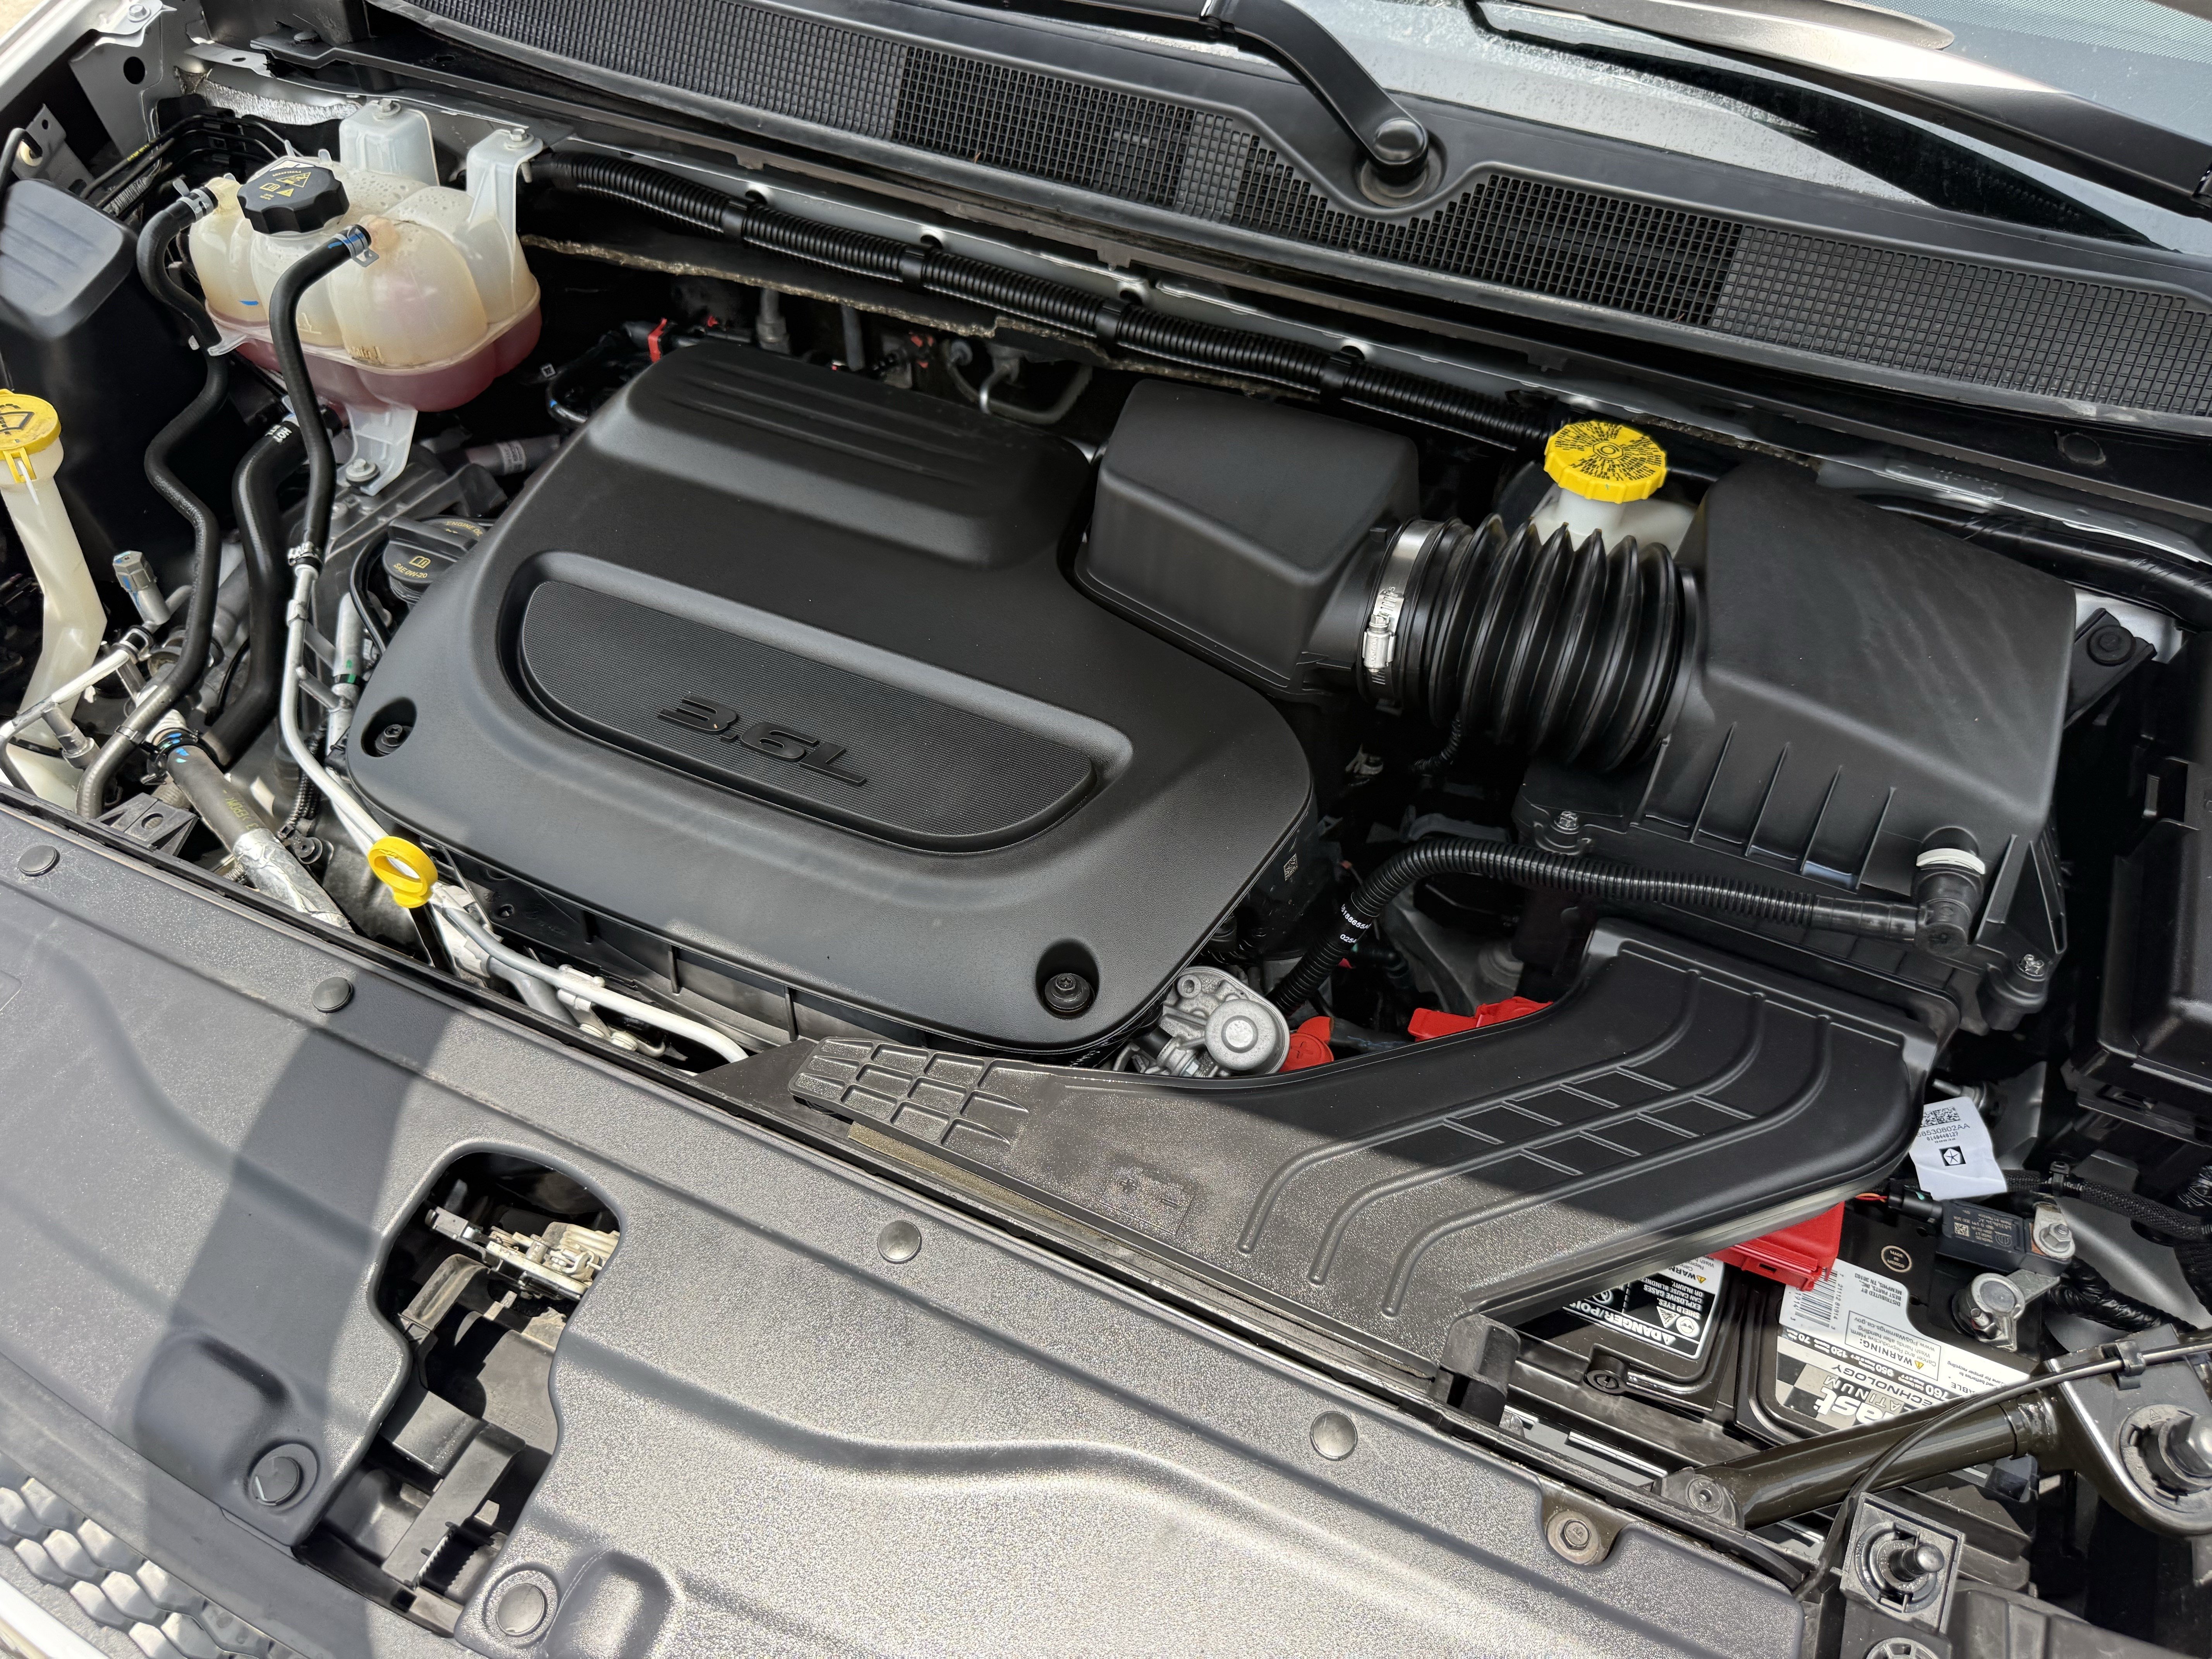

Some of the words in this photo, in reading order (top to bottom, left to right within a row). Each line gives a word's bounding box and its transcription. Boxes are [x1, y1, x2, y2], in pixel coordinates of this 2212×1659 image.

[273, 427, 292, 443] HOT
[446, 521, 475, 531] ENGINE
[393, 563, 408, 575] SAE
[405, 570, 428, 578] 0W-20
[658, 697, 867, 787] 3.6L
[1700, 1259, 1714, 1268] Wash
[1854, 1273, 1869, 1282] 38103
[1643, 1284, 1665, 1298] GASES
[1669, 1288, 1688, 1299] CAUSE
[1671, 1281, 1693, 1294] INJURY.
[1665, 1292, 1702, 1311] EXPLOSIVE
[1690, 1295, 1703, 1304] CAN
[1869, 1291, 1901, 1307] DISTRIBUTED
[1889, 1293, 1901, 1301] BEST
[1657, 1298, 1676, 1311] EYES.
[1676, 1305, 1701, 1319] SHIELD
[1798, 1334, 1810, 1344] 70
[1868, 1336, 1903, 1353] Reproductive
[1883, 1336, 1895, 1344] after
[1831, 1346, 1848, 1358] 120
[1859, 1338, 1912, 1366] WARNING:
[1897, 1341, 1913, 1352] hands
[1915, 1348, 1930, 1358] Wash
[1917, 1355, 1936, 1367] Cancer
[1875, 1364, 1894, 1377] 950
[1830, 1364, 1932, 1407] ECHNOLOGY
[1951, 1382, 1975, 1394] ABLE
[1823, 1376, 1912, 1412] ATINUM
[1925, 1384, 1949, 1401] 760
